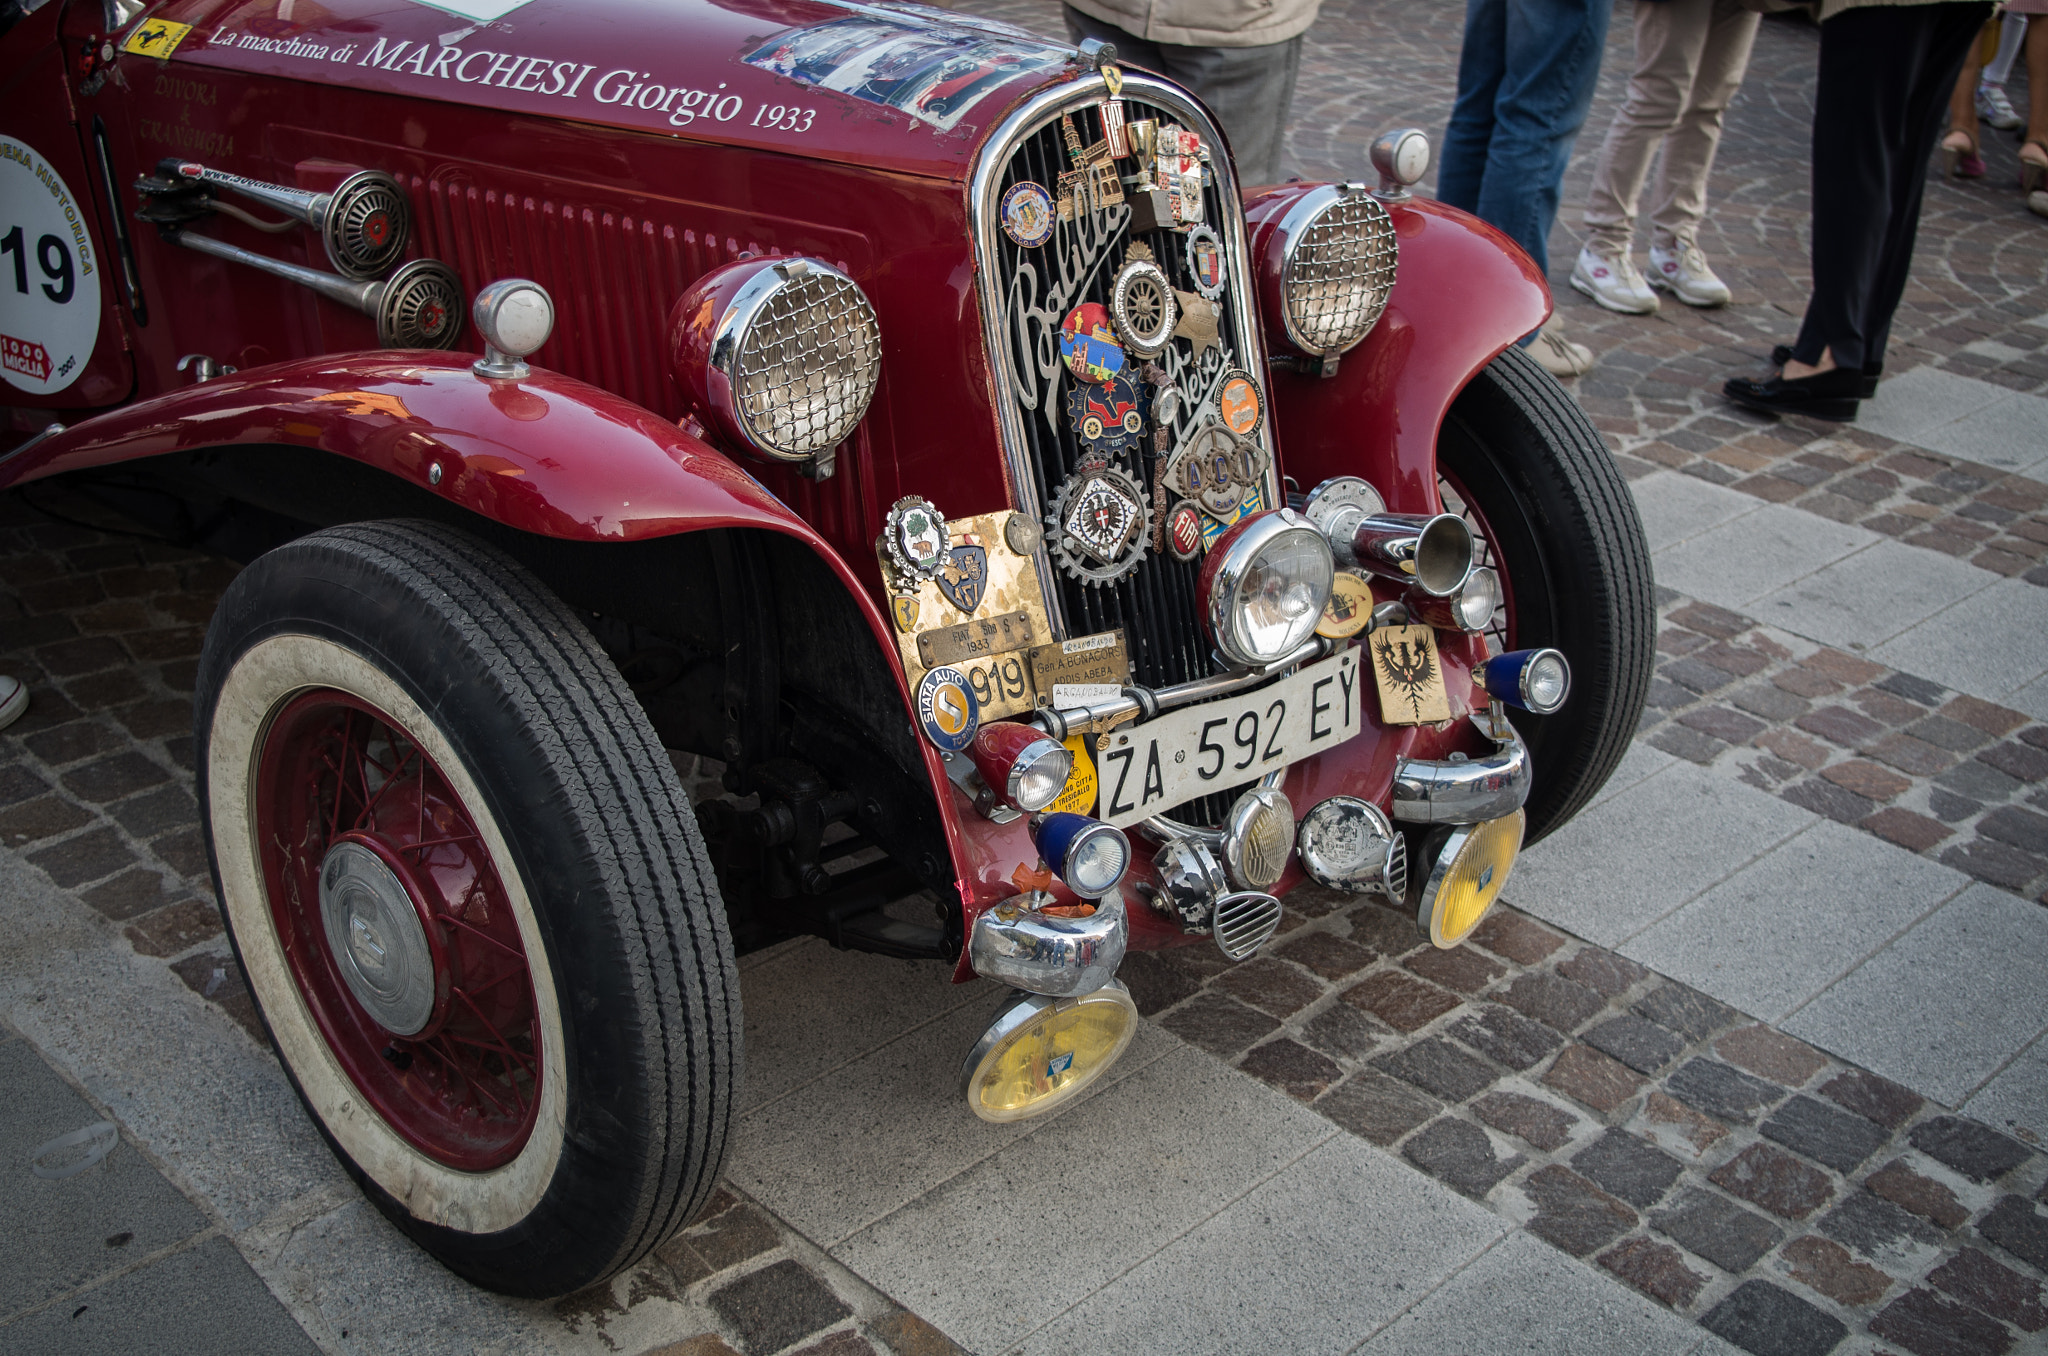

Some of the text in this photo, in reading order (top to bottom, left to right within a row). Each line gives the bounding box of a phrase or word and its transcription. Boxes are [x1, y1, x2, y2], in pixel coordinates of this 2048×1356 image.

[153, 74, 218, 106] DIVORA
[208, 26, 817, 133] La macchina di MARCHESI Giorgio 1933
[1003, 183, 1037, 207] CORTINA
[36, 163, 94, 277] HISTORICA
[1, 336, 44, 361] 1000
[4, 354, 46, 377] MIGLIA
[58, 355, 76, 377] 2007
[1173, 512, 1199, 551] FIAT
[890, 519, 918, 574] AUTOMOBILE
[952, 619, 1011, 643] FIAT 508 S
[1338, 622, 1361, 635] BOLOGNA
[967, 639, 990, 654] 1933
[1067, 646, 1124, 668] BONACORSI
[969, 658, 1026, 707] 919
[1054, 666, 1113, 685] ADDIS ABEBA
[921, 670, 964, 724] SIATA AUTO
[952, 717, 977, 747] TORINO
[1105, 663, 1357, 818] ZA 592 EY
[1065, 799, 1081, 811] 1977
